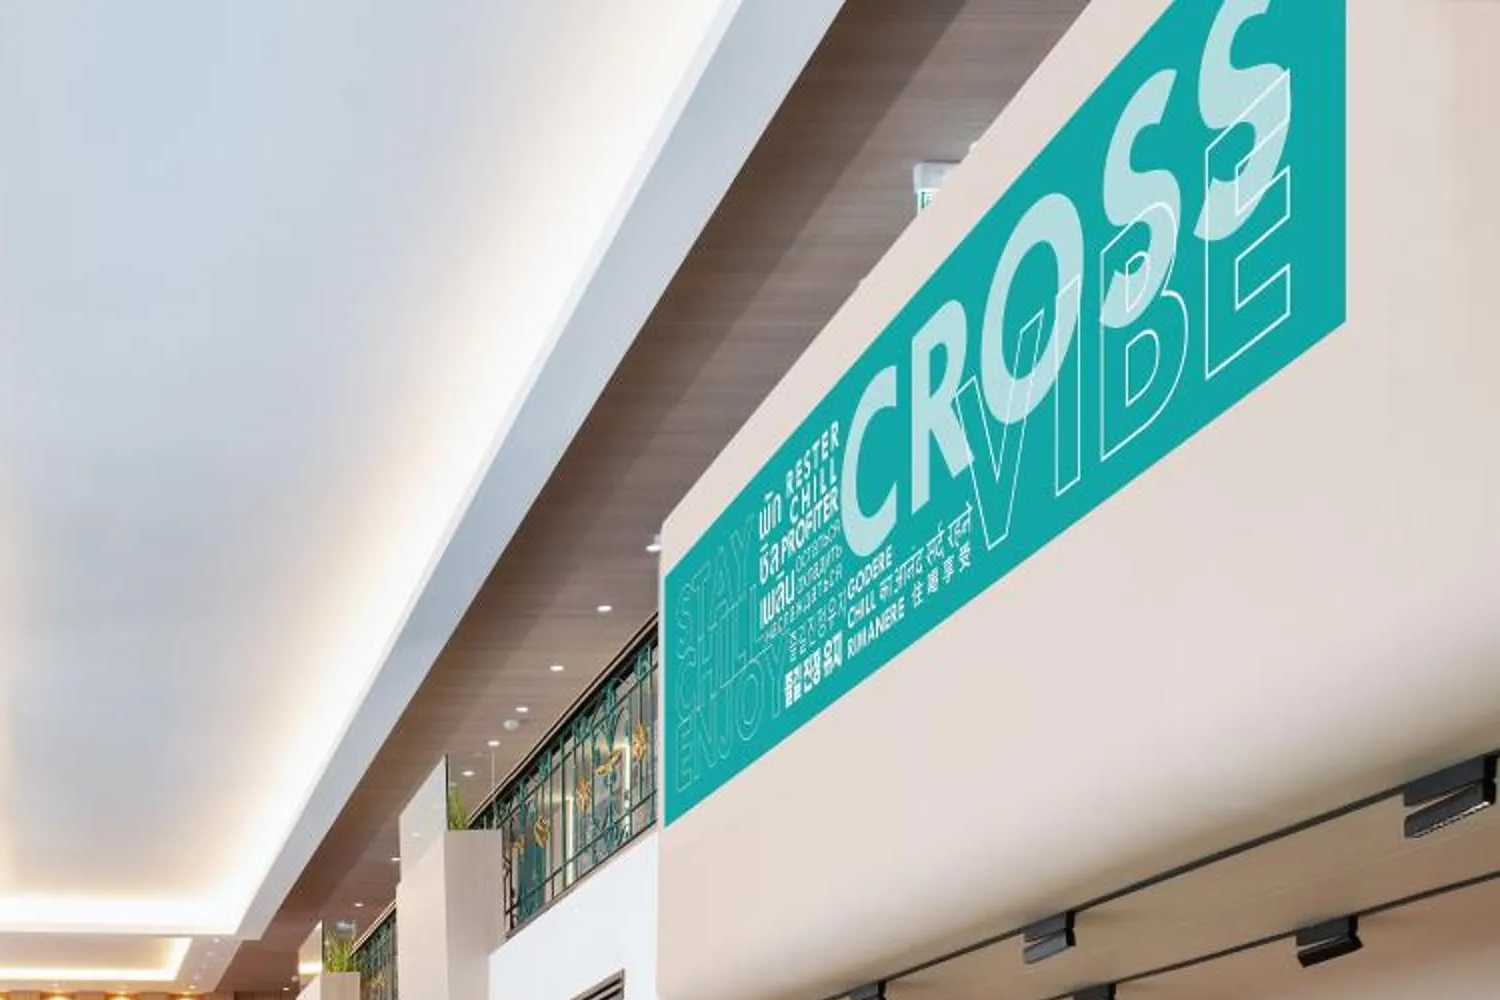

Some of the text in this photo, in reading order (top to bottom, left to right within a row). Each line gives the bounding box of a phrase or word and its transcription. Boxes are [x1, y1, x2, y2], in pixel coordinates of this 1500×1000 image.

[841, 0, 1290, 556] CROSS
[954, 68, 1291, 551] VIBE
[786, 421, 840, 495] RESTER
[790, 459, 837, 524] CHILL
[781, 486, 839, 564] PROFITER
[677, 512, 754, 667] STAY
[847, 544, 893, 600] GODERE
[847, 591, 877, 629] CHILL
[676, 583, 772, 720] CHILL
[847, 596, 905, 660] RIMANERE
[677, 643, 788, 793] ENJOY
